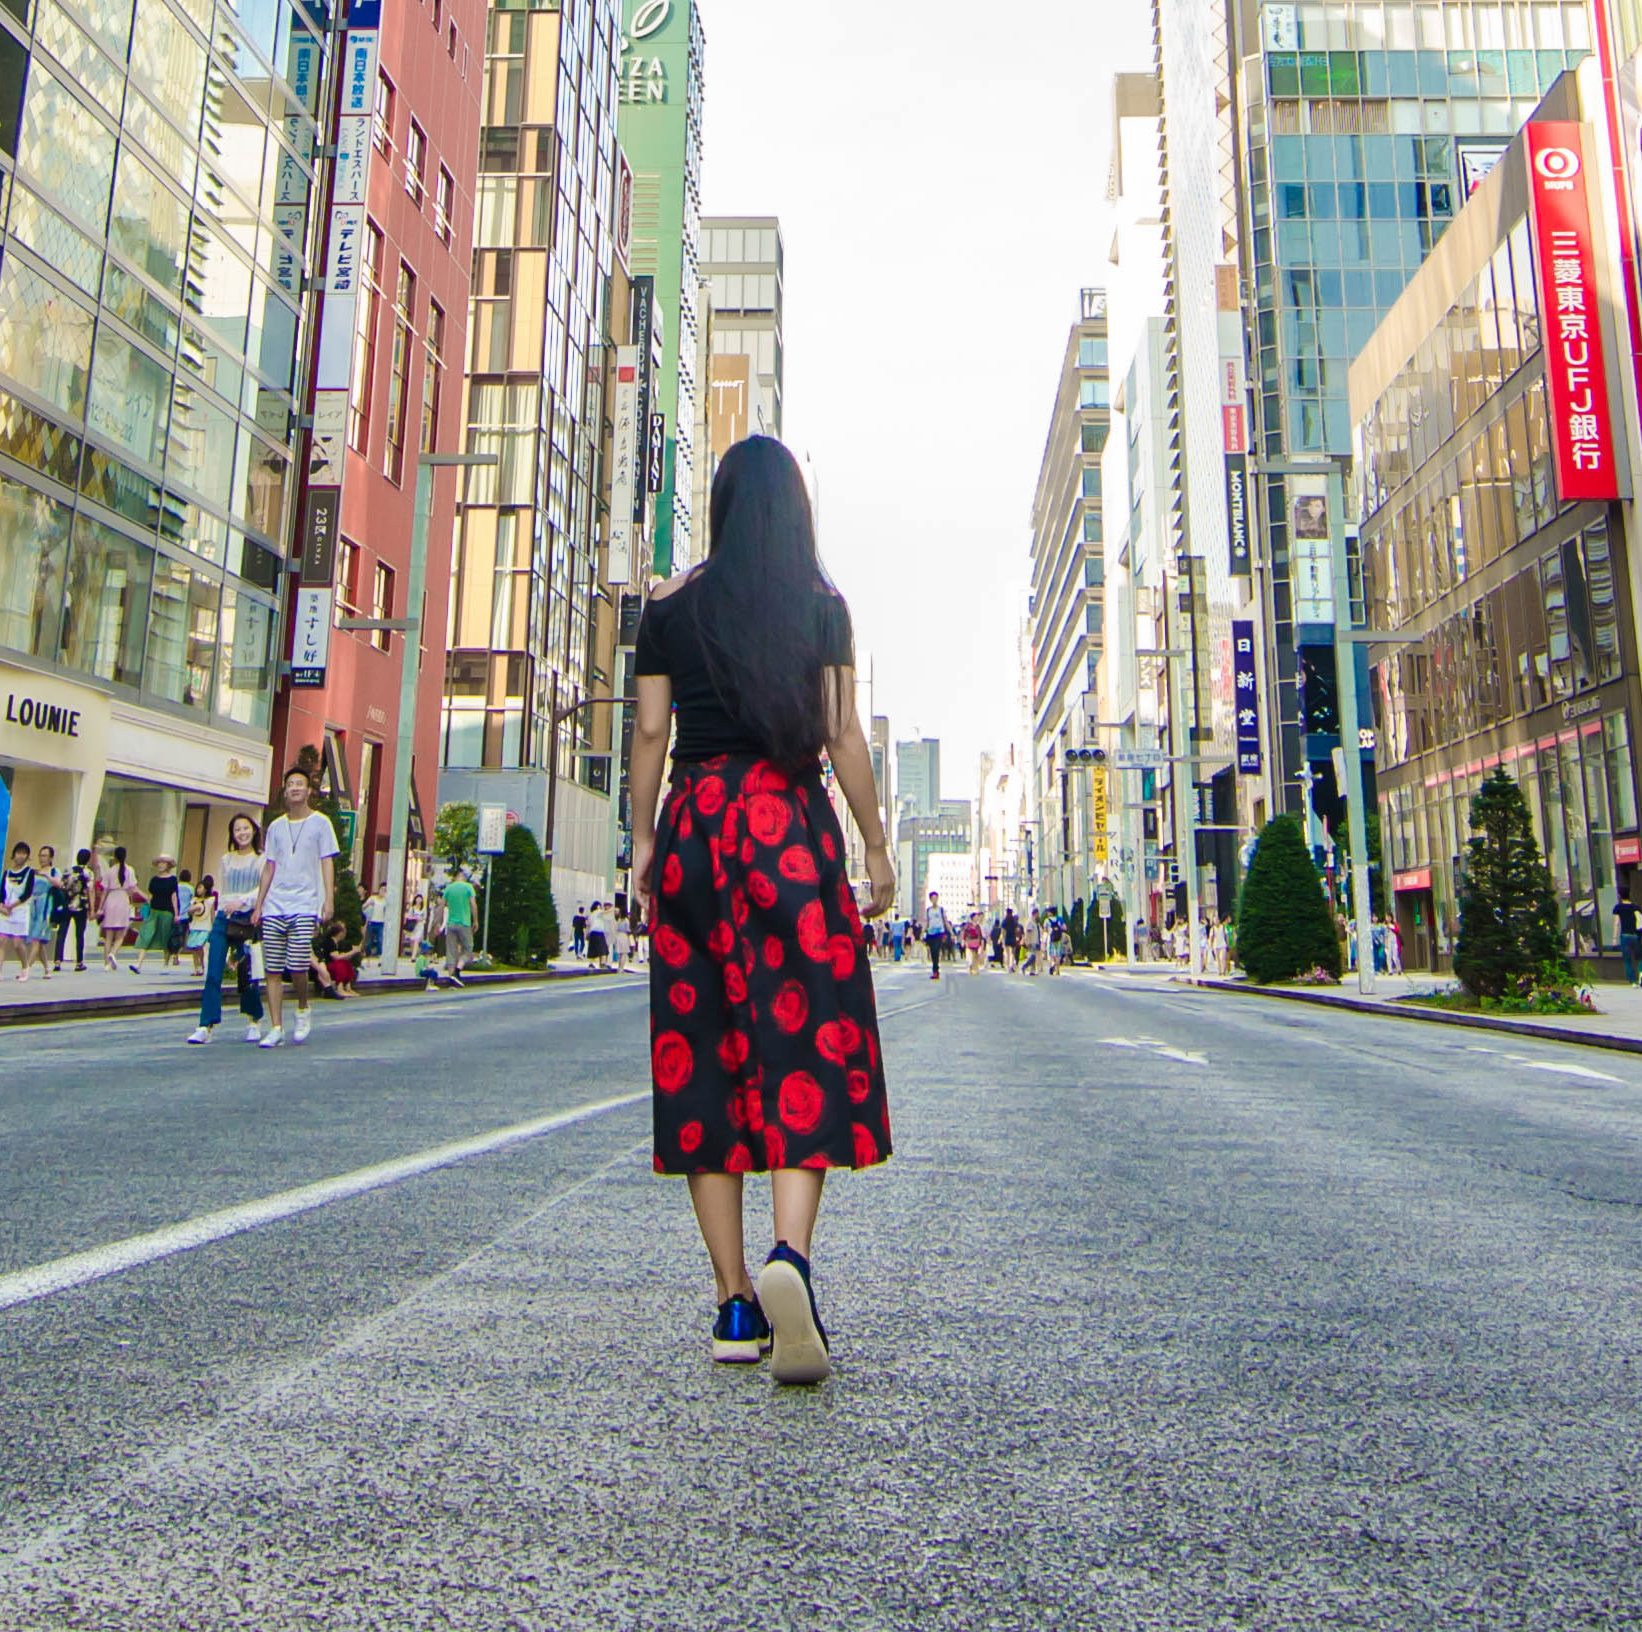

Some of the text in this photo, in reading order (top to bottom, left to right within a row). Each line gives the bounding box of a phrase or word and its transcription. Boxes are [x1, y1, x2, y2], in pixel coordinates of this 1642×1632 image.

[620, 56, 664, 77] ZA
[1552, 231, 1601, 470] 三菱東京UFJ銀行
[1230, 471, 1246, 548] MONTBLANC
[5, 694, 81, 738] LOUNIE
[1236, 638, 1256, 727] 日新堂
